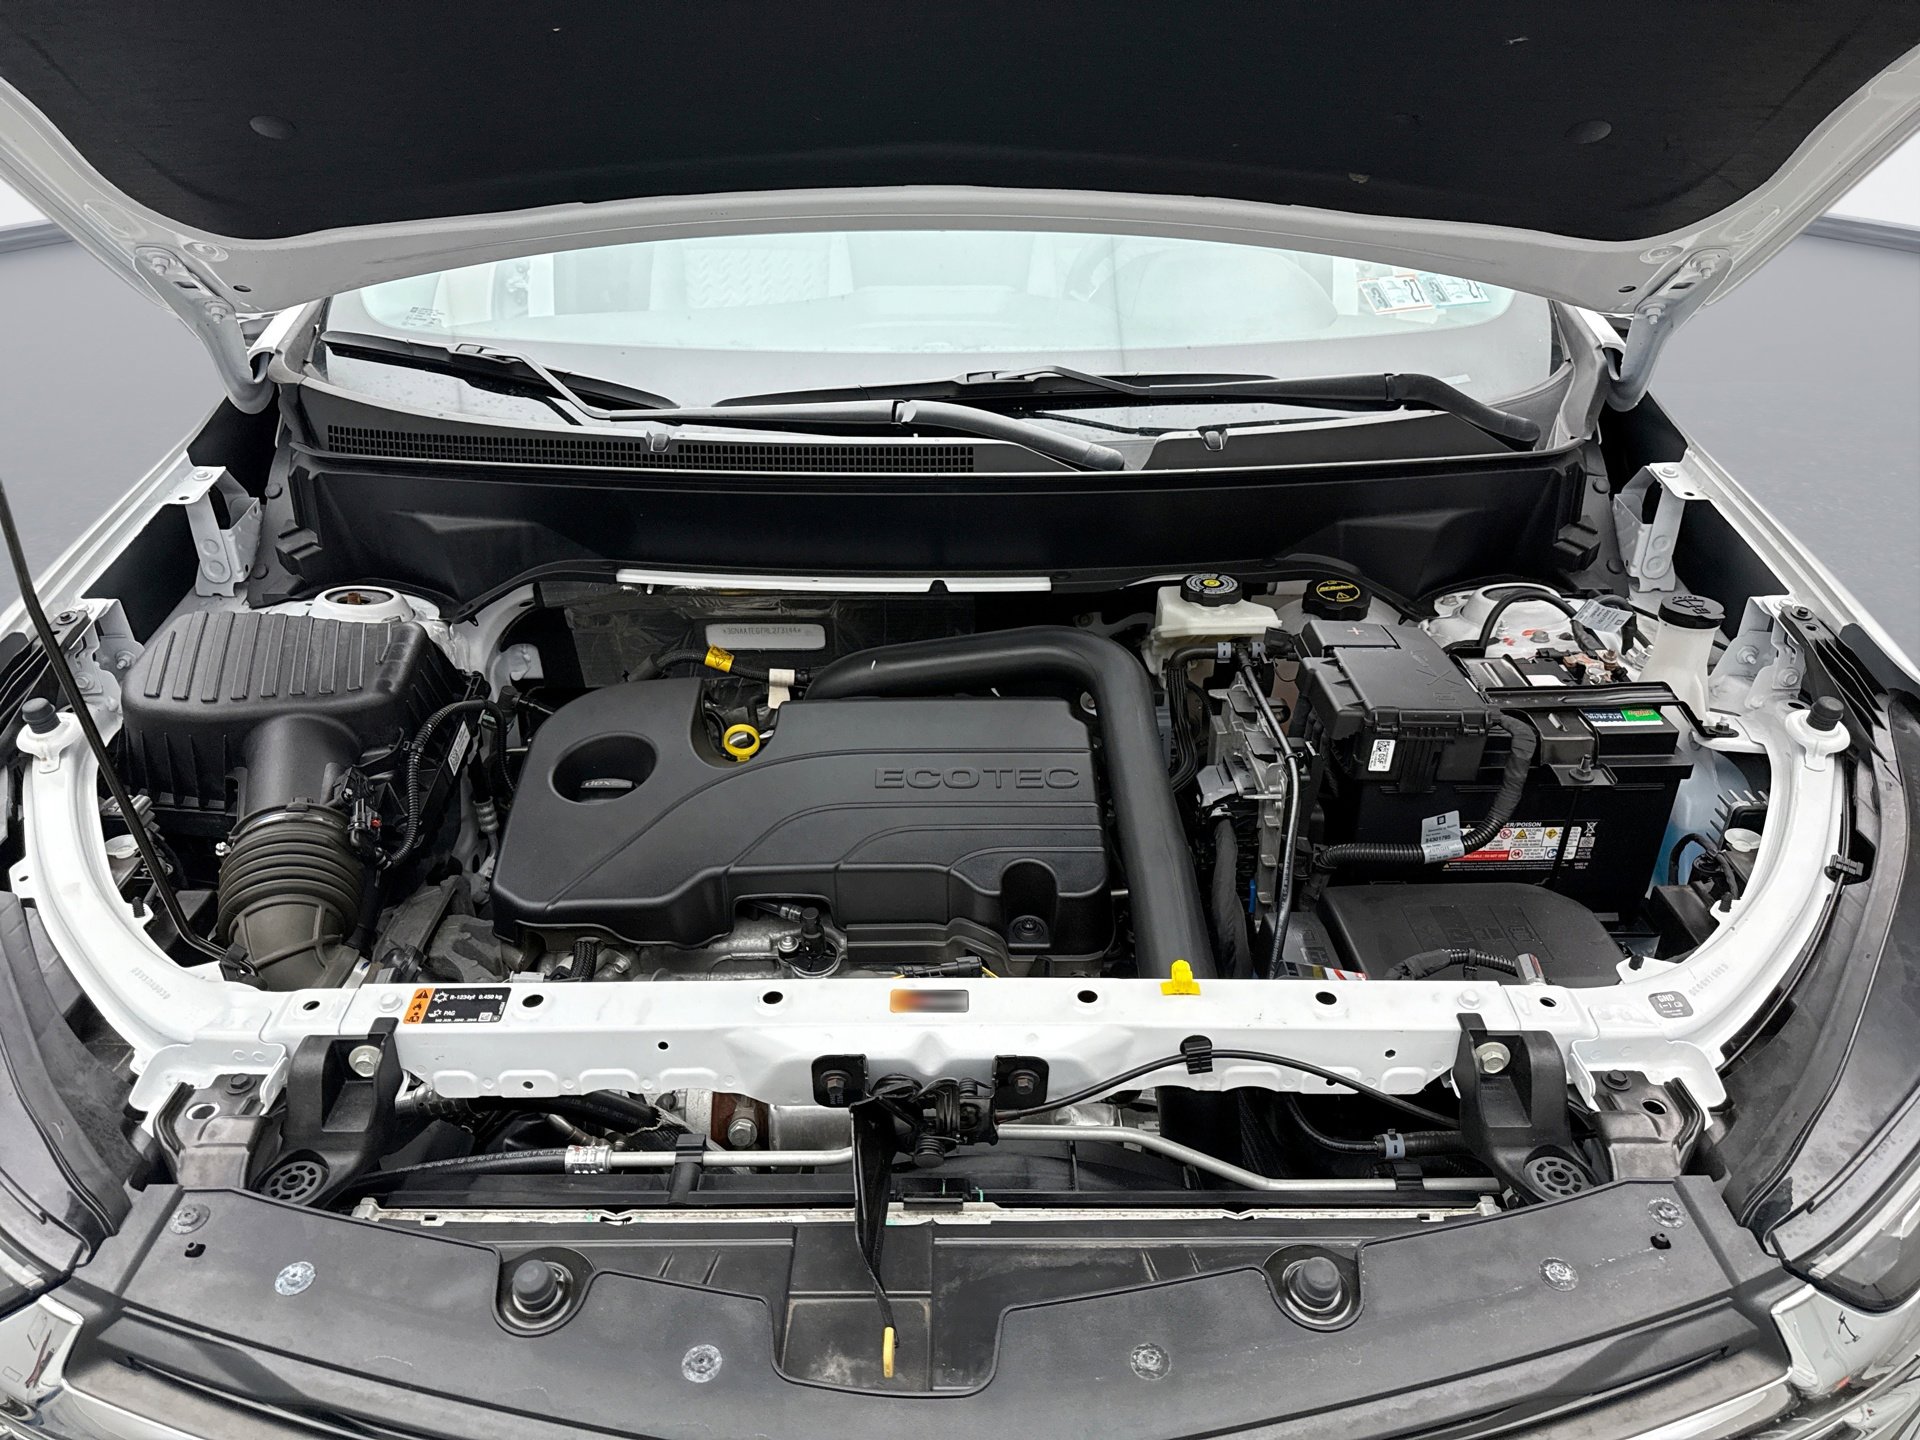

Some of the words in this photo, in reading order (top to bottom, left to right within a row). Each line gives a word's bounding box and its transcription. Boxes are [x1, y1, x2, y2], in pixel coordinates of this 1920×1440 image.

[1403, 279, 1425, 303] 27
[874, 767, 1080, 790] ECOTEC
[1657, 994, 1675, 1003] GND
